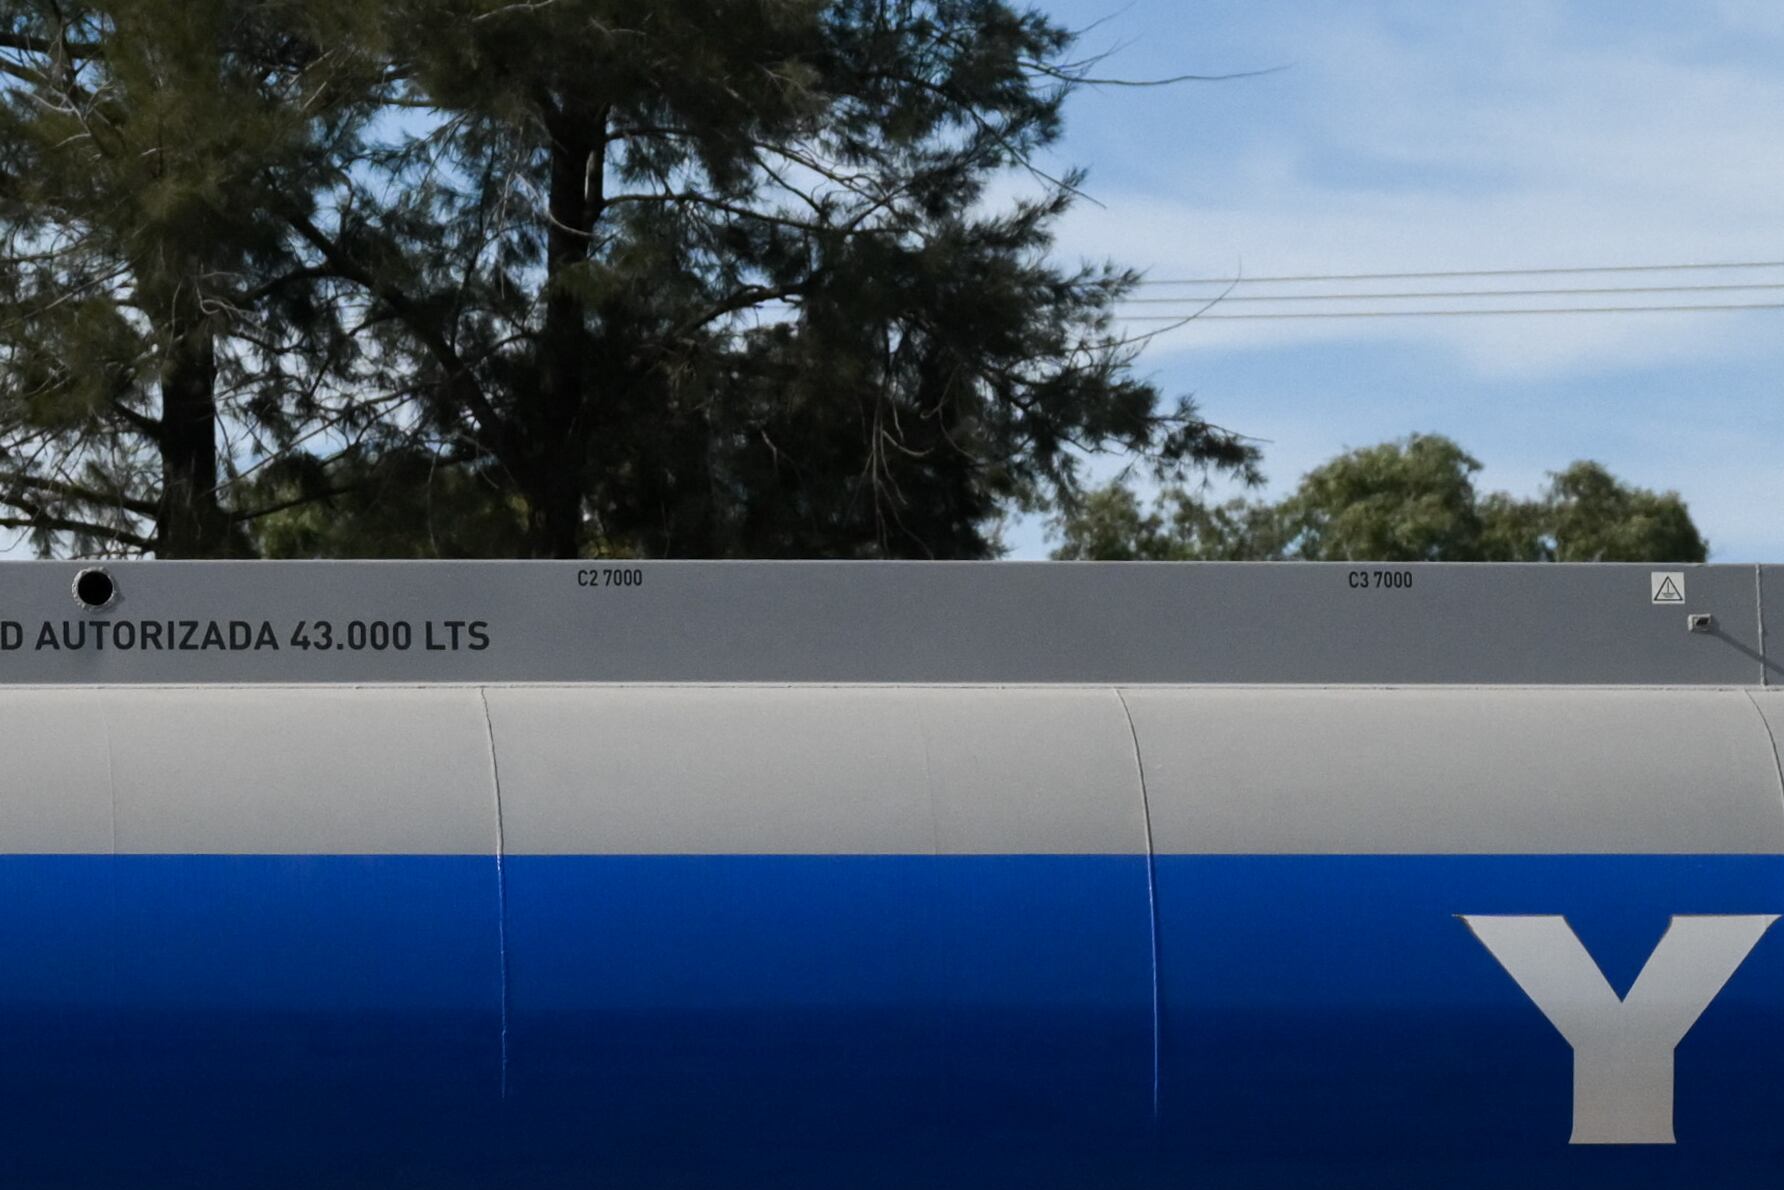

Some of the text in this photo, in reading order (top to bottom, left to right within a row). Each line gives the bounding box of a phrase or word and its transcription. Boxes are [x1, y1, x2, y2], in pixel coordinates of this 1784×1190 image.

[577, 569, 643, 587] C2 7000
[1348, 571, 1413, 589] C3 7000
[0, 620, 490, 651] D AUTORIZADA 43.000 LTS
